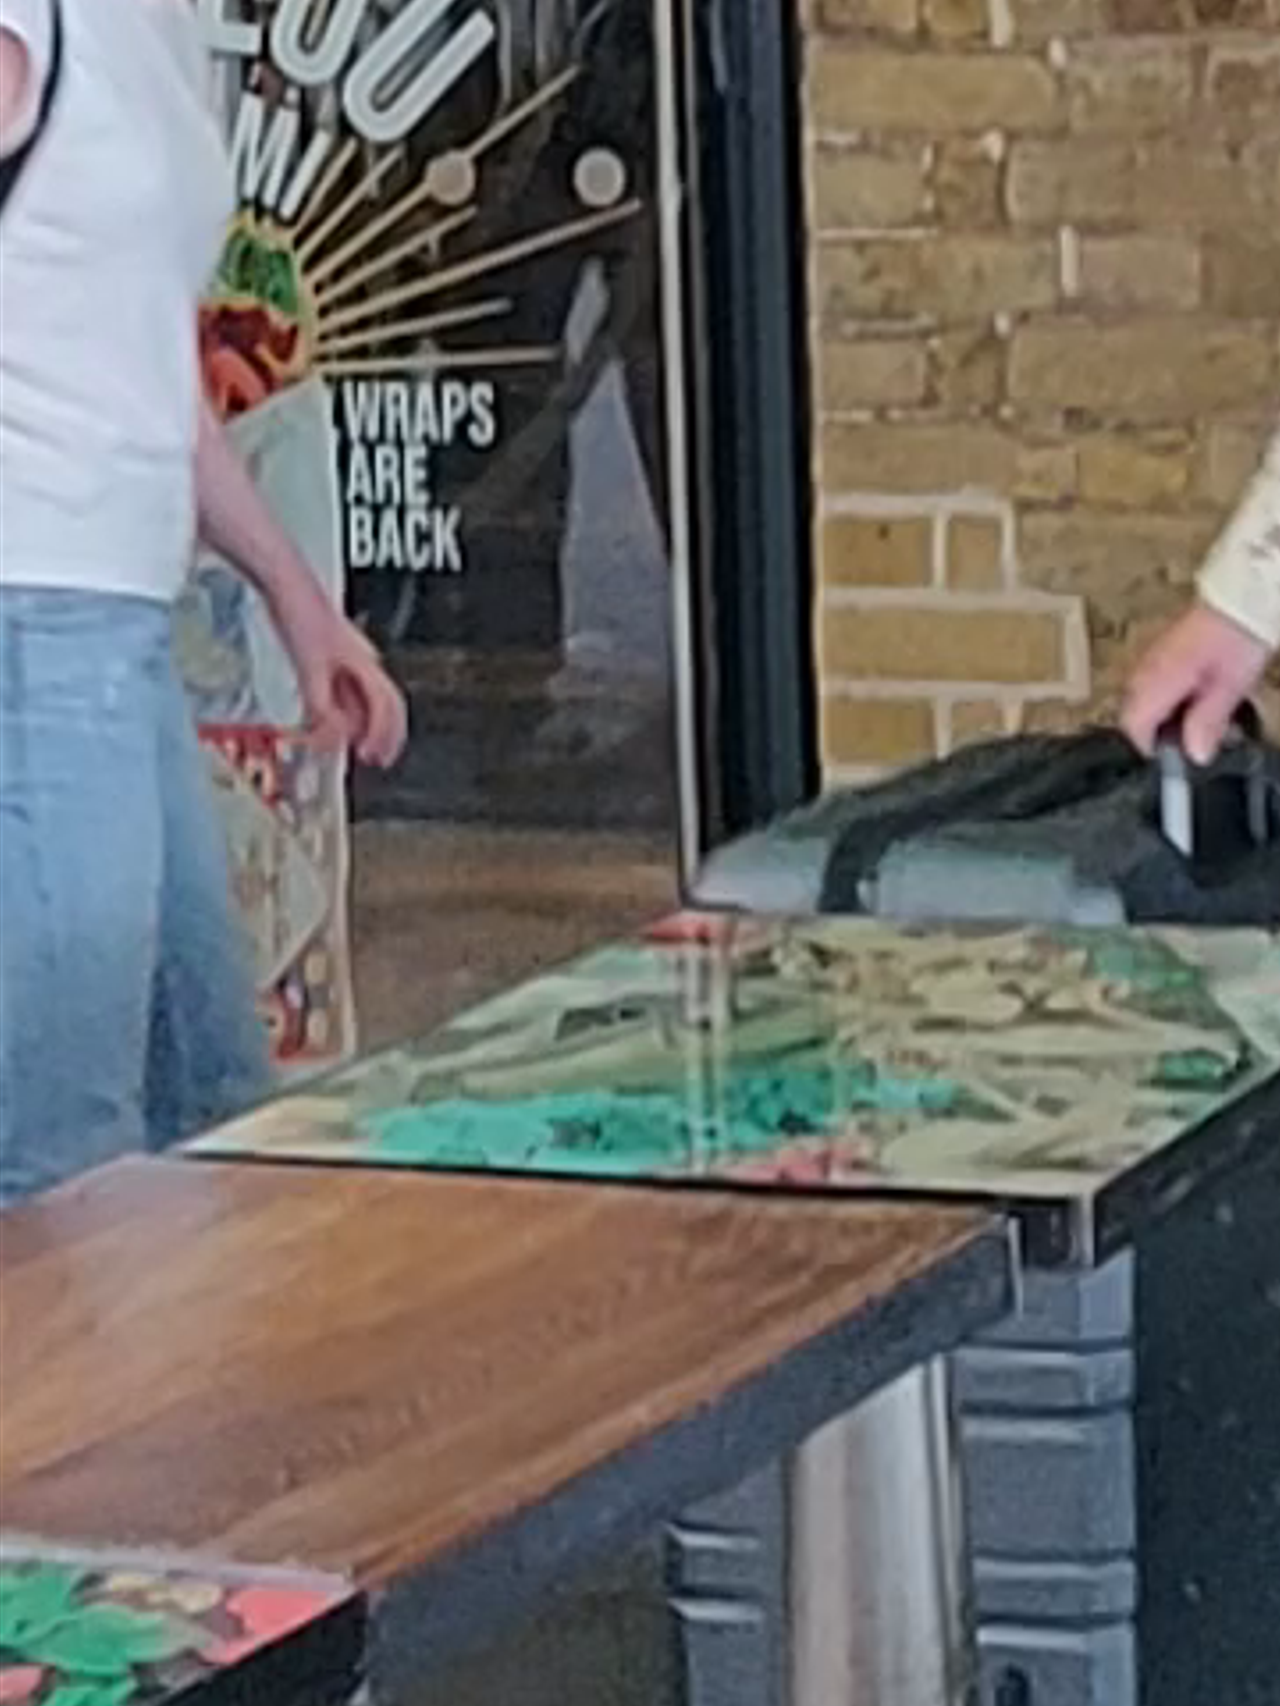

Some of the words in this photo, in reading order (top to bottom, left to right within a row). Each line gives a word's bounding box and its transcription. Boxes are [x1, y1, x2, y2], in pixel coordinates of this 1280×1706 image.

[342, 380, 497, 448] WRAPS
[347, 443, 431, 507] ARE
[350, 505, 463, 573] BACK
